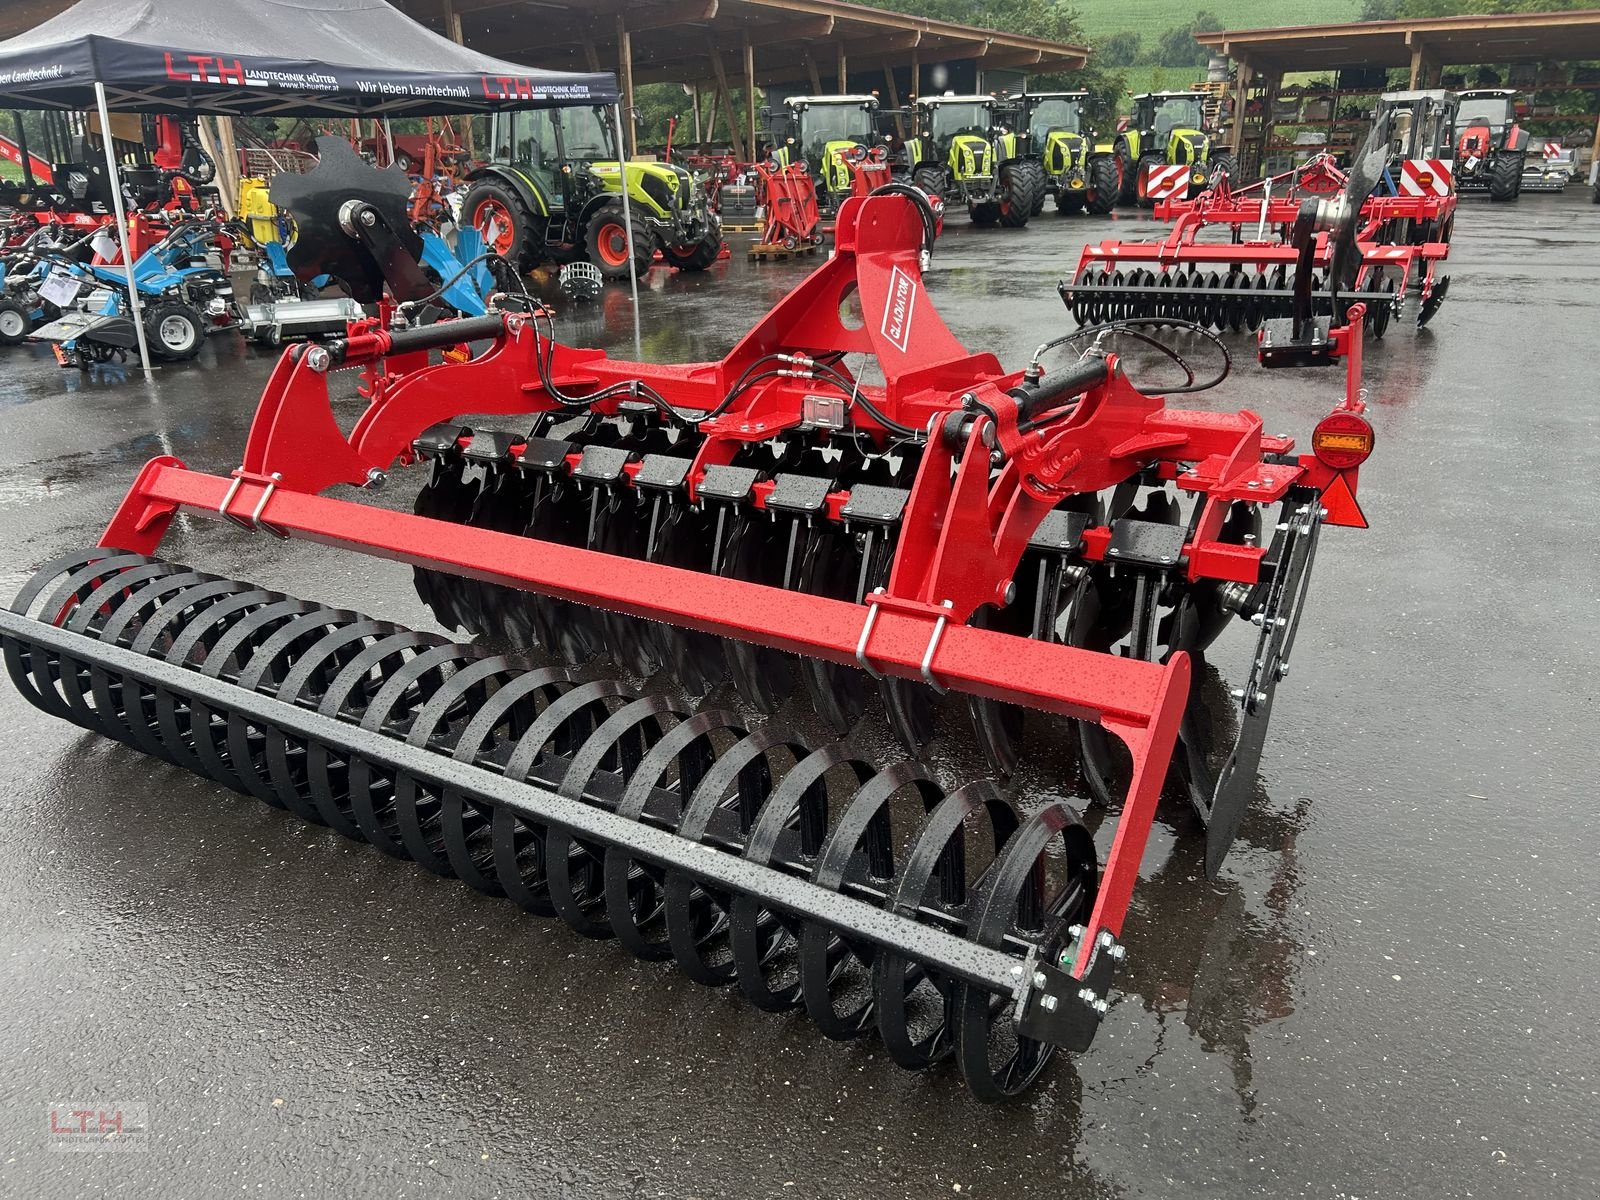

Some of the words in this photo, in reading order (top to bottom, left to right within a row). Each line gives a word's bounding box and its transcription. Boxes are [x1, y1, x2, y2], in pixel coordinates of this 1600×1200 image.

[12, 64, 64, 82] Landtechnik!
[164, 52, 246, 85] LTH
[245, 69, 306, 81] LANDTECHNIK
[306, 72, 338, 84] HÜTTER
[356, 80, 377, 92] Wir
[378, 81, 408, 94] leben
[409, 84, 470, 97] Landtechnik!
[481, 76, 533, 100] LTH
[531, 85, 569, 93] LANDTECHNIK
[889, 277, 909, 340] GLADIATOR
